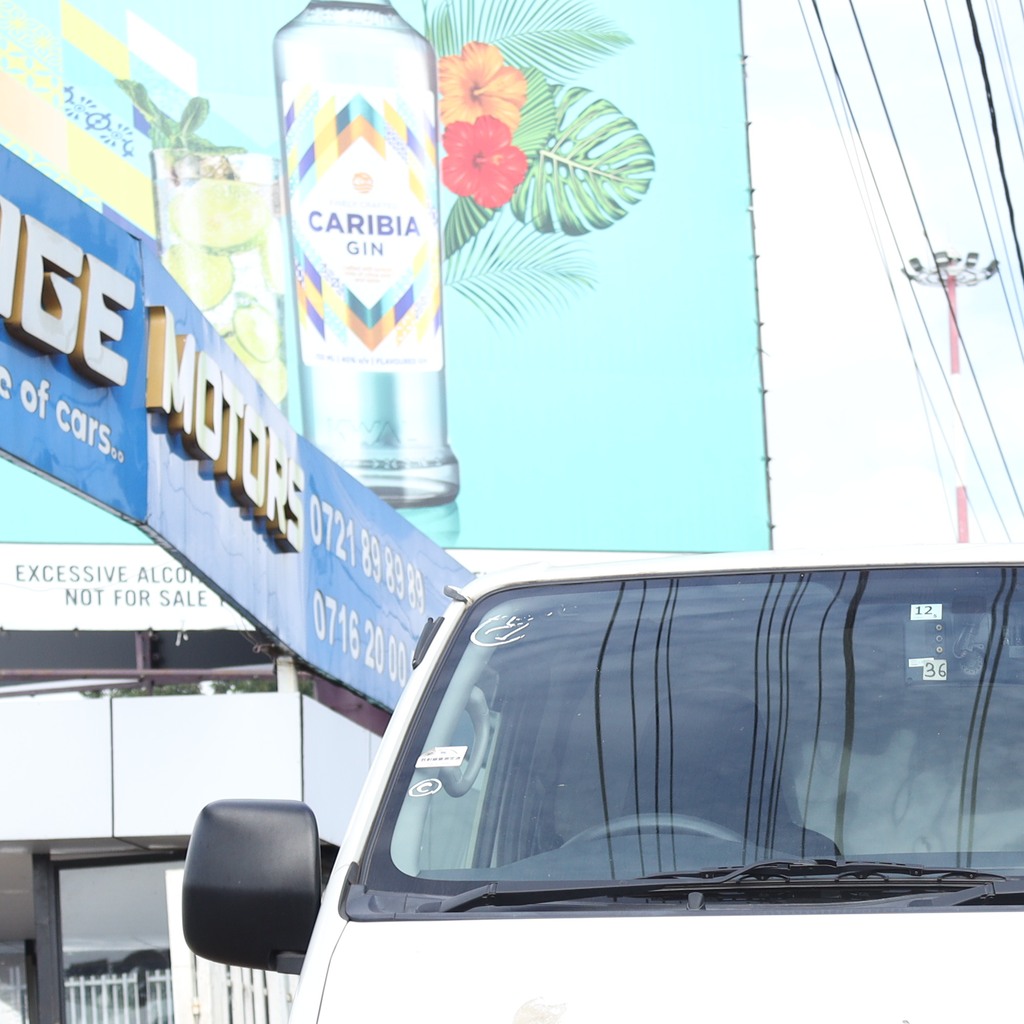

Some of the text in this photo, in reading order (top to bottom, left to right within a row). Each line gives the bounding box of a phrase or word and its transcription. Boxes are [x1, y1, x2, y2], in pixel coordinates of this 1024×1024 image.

[308, 210, 421, 237] CARIBIA
[346, 241, 384, 257] GIN
[20, 379, 50, 420] of
[150, 305, 305, 553] MOTORS
[310, 494, 426, 616] 0721 89 89 89
[15, 564, 128, 583] EXCESSIVE
[65, 588, 104, 606] NOT
[114, 590, 150, 607] FOR
[160, 590, 208, 607] SALE
[915, 605, 933, 615] 12
[313, 588, 360, 661] 0716
[364, 619, 385, 675] 20
[924, 662, 947, 688] 36
